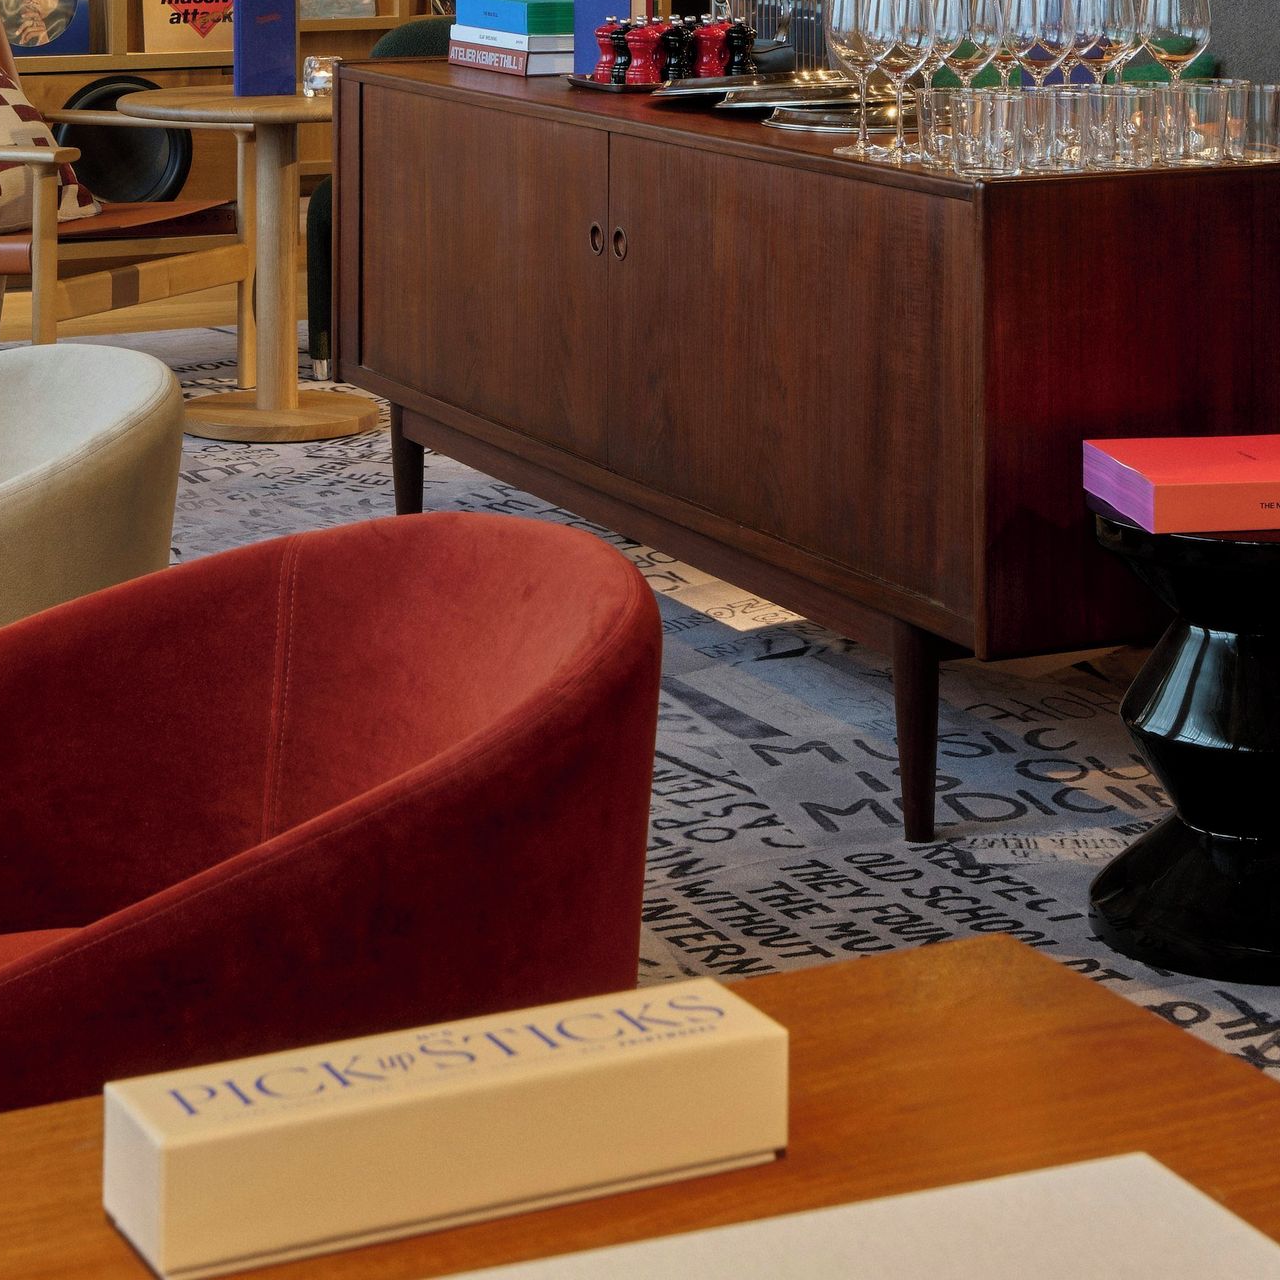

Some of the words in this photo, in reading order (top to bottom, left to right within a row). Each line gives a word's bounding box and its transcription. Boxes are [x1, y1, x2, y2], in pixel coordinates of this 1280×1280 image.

[450, 45, 477, 64] ATELIER
[476, 50, 499, 67] KEMPE
[499, 53, 518, 70] THILL
[1259, 501, 1275, 509] THE
[778, 858, 883, 903] THEY
[843, 851, 924, 883] OLD
[673, 878, 835, 961] WITHOUT
[748, 878, 837, 923] THE
[167, 1054, 388, 1117] PICK
[378, 1050, 418, 1077] up
[419, 994, 726, 1072] STICKS
